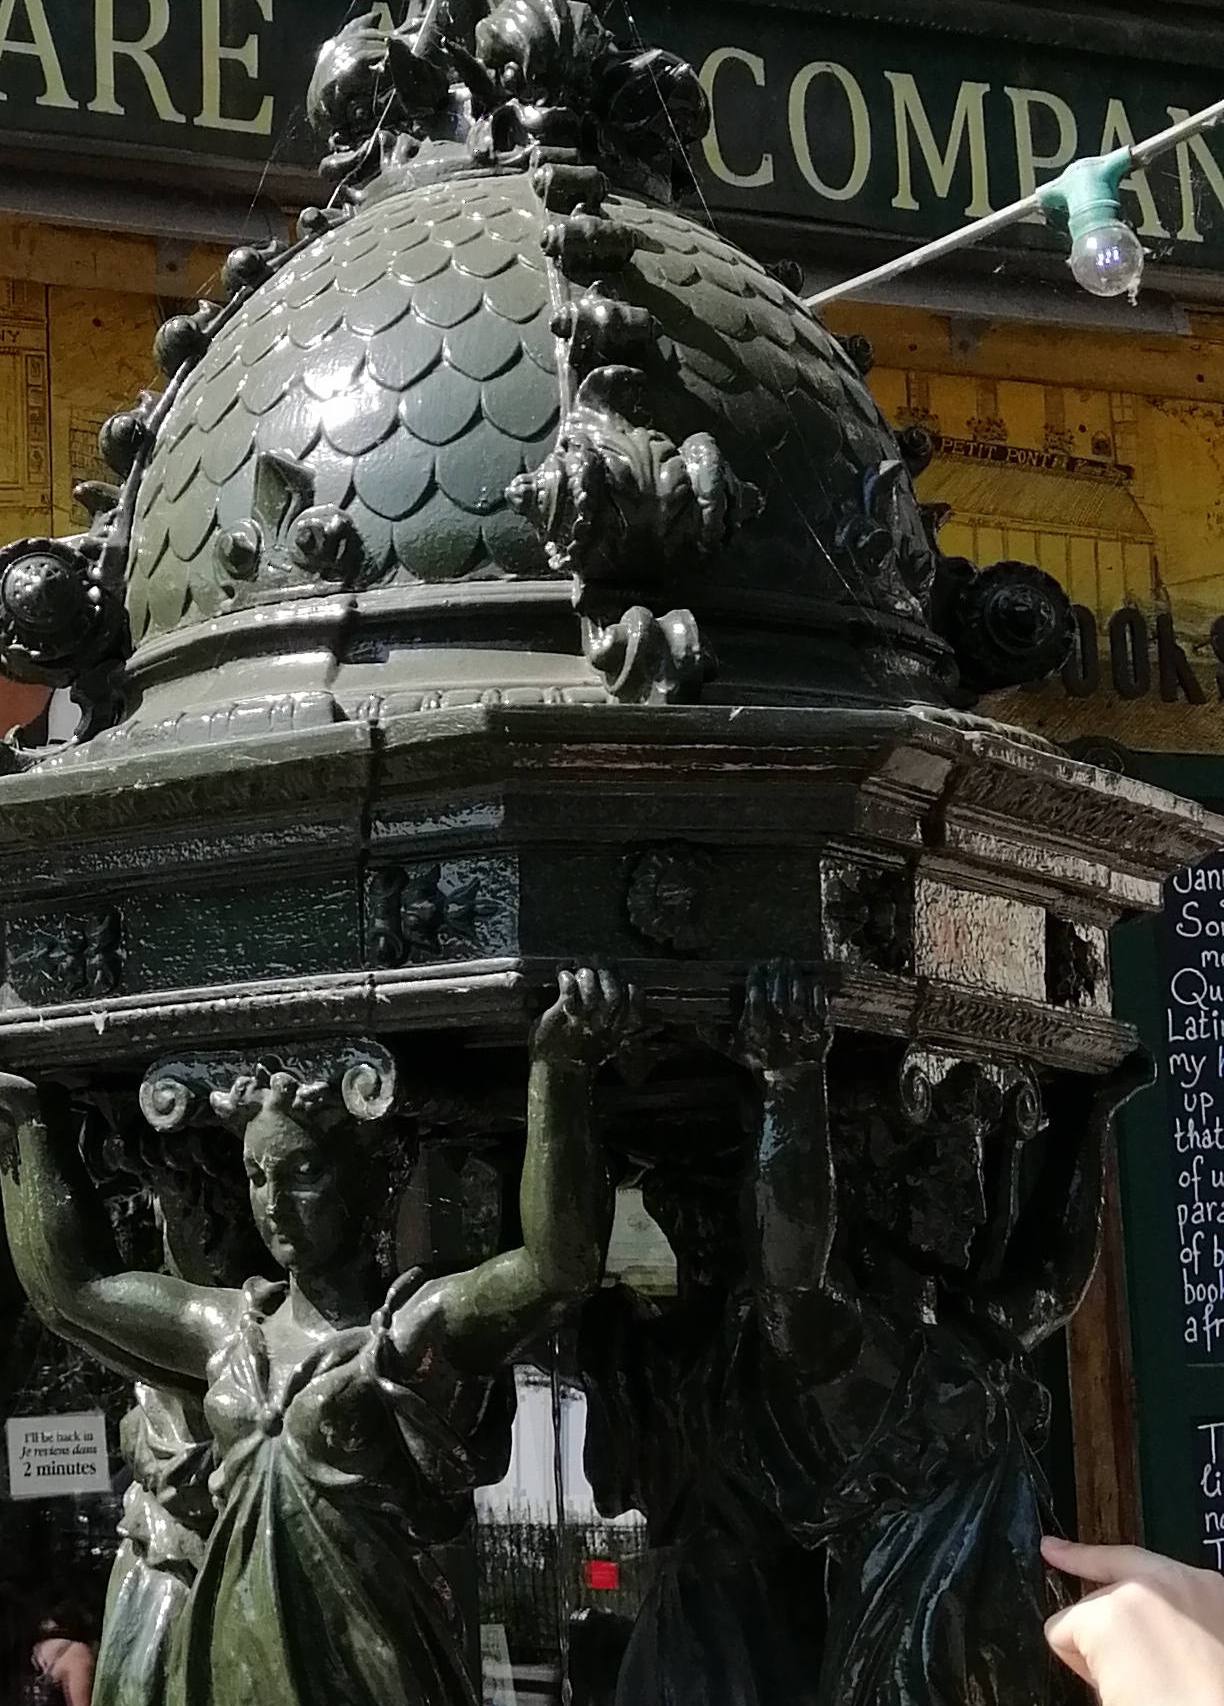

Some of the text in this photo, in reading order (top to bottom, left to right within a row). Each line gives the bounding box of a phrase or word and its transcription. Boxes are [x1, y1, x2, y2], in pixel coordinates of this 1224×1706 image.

[941, 439, 998, 461] PETIT
[1006, 447, 1062, 470] PONT
[1167, 1007, 1224, 1043] Lati
[1168, 1050, 1208, 1090] my
[1183, 1091, 1215, 1127] up
[1173, 1116, 1224, 1154] that
[1178, 1154, 1205, 1203] of
[1179, 1229, 1205, 1276] of
[1182, 1266, 1224, 1306] boo
[19, 1444, 98, 1460] Je reviens dans
[41, 1431, 53, 1443] be
[56, 1430, 81, 1443] back
[83, 1432, 94, 1442] in
[22, 1460, 97, 1477] 2 minutes
